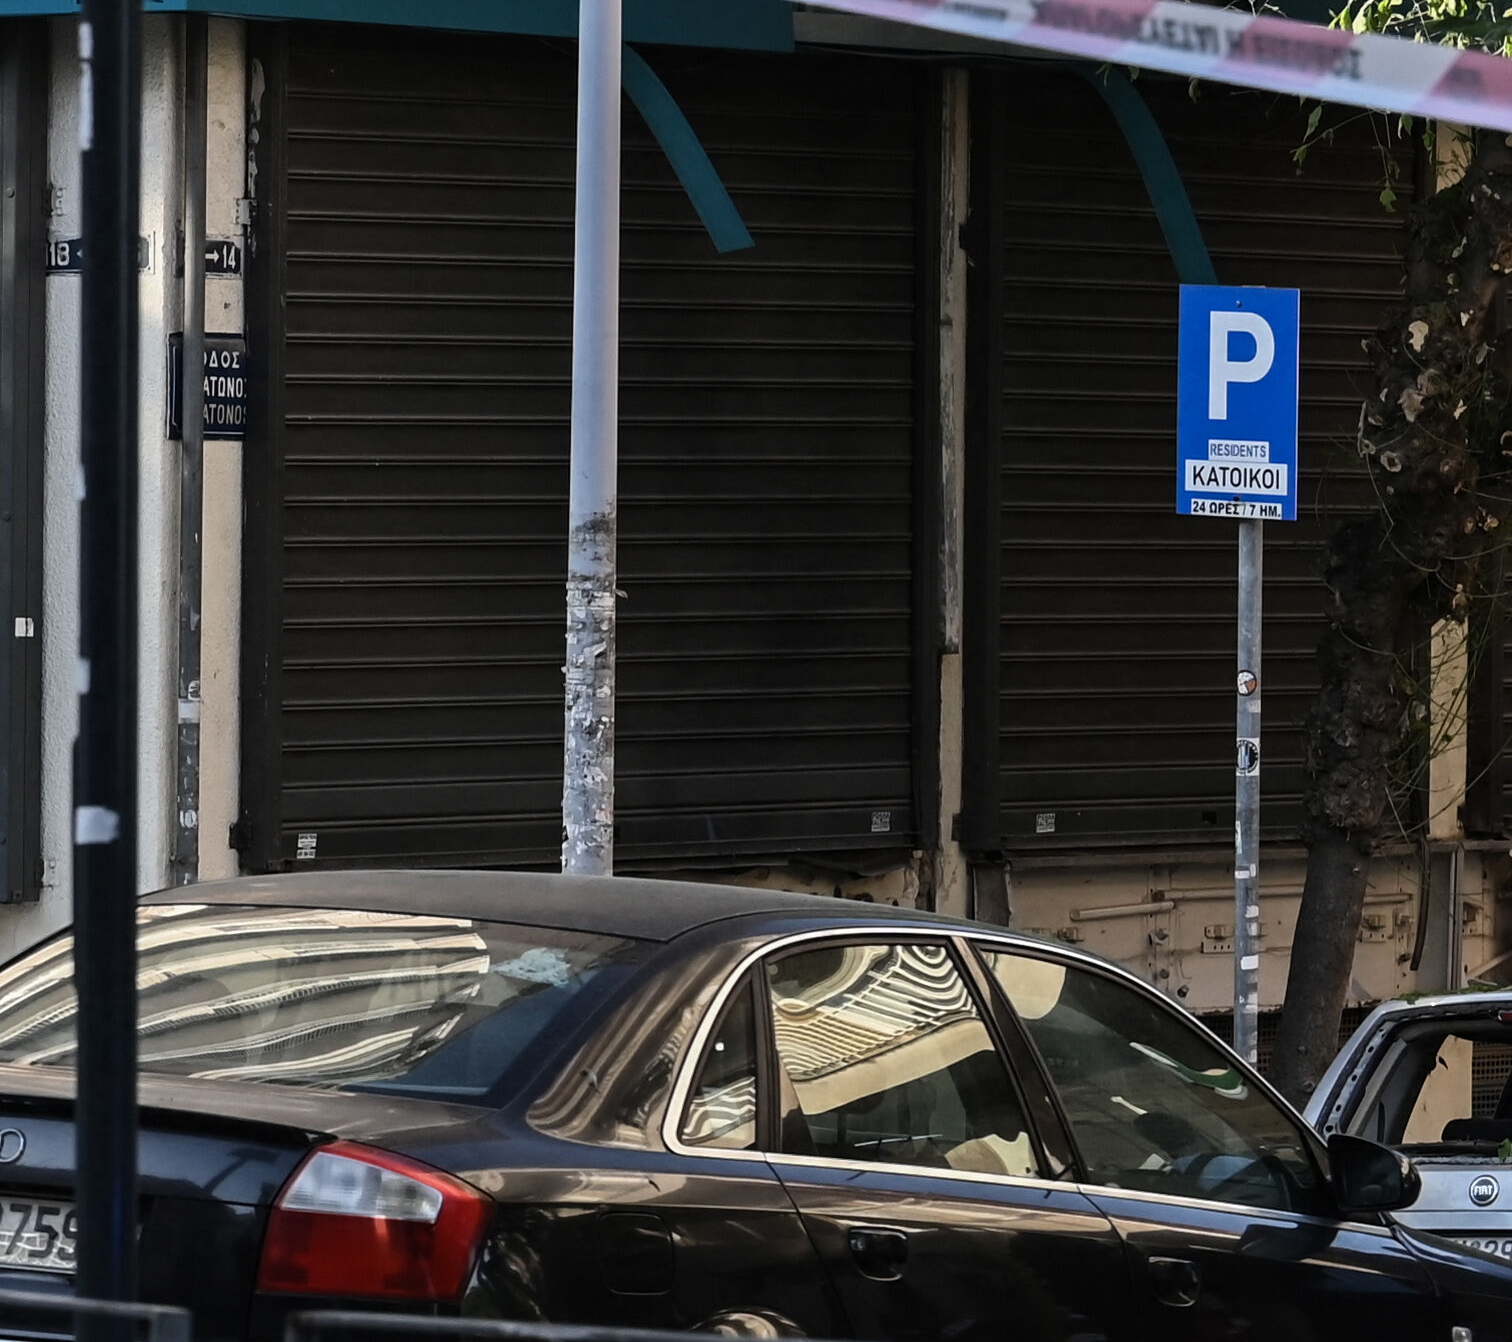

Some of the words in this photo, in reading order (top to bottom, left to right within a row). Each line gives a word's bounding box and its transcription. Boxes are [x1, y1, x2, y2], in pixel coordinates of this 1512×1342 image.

[49, 242, 70, 266] 18
[222, 245, 237, 269] 14
[1208, 310, 1275, 420] P
[1210, 443, 1267, 458] RESIDENTS
[1192, 465, 1280, 490] ΚΑΤΟΙΚΟΙ
[1192, 500, 1206, 513] 24
[1209, 502, 1240, 516] ΩΡΕΣ
[1250, 504, 1257, 516] 7
